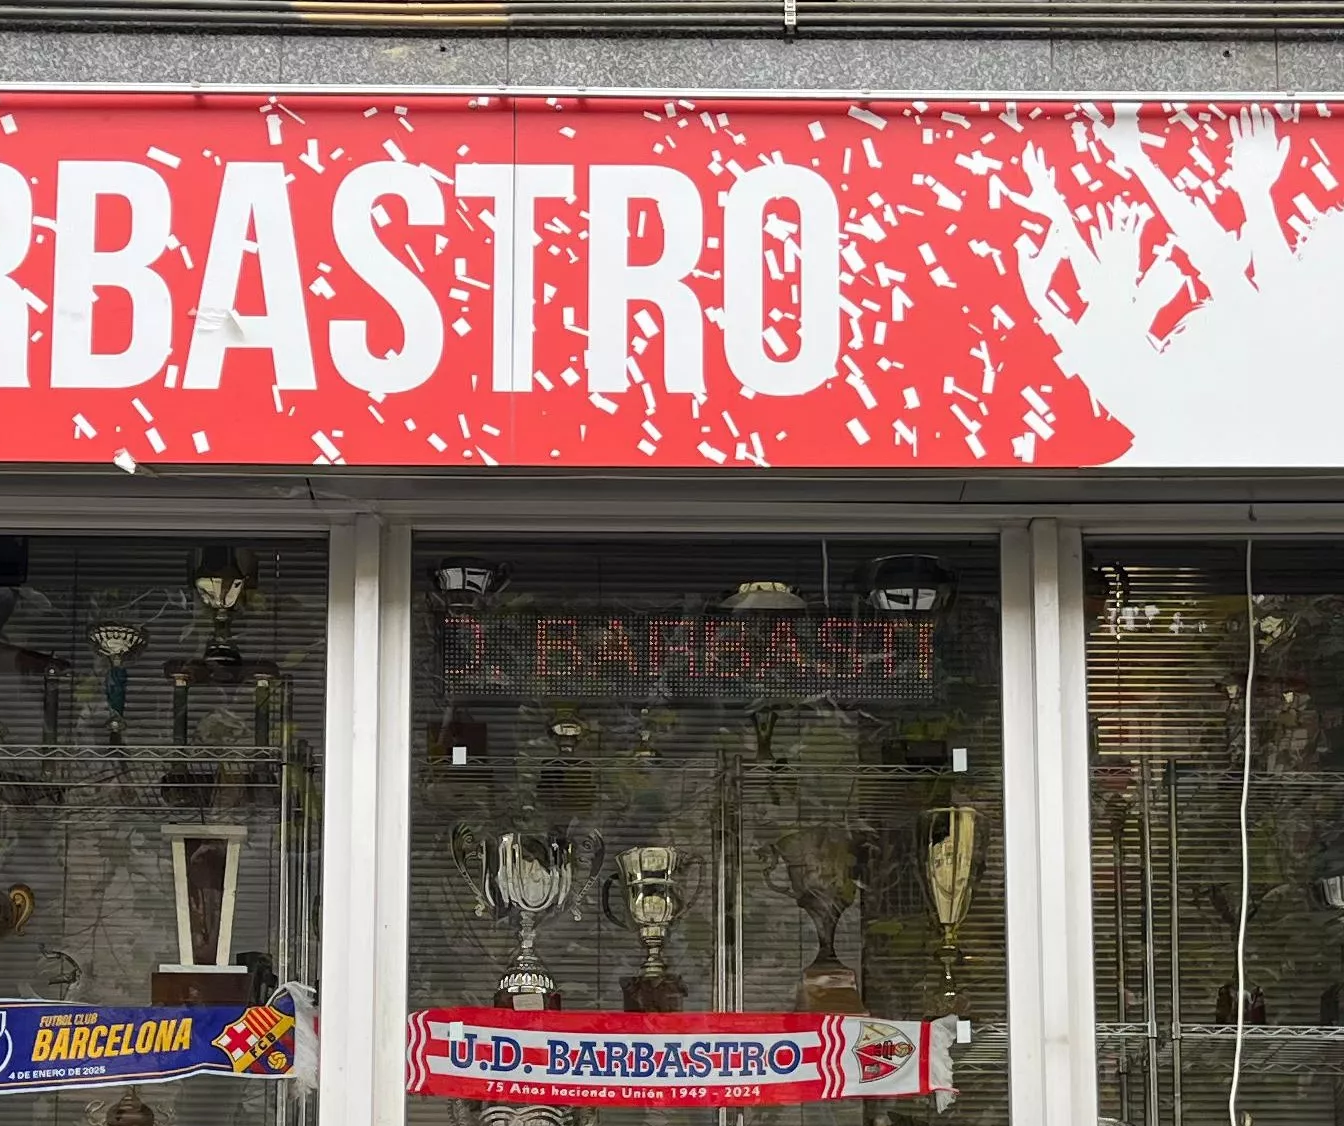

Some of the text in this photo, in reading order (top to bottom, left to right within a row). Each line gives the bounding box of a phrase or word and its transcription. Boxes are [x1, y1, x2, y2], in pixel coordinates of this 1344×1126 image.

[74, 1012, 98, 1026] CLUB
[30, 1016, 193, 1063] BARCELONA
[447, 1032, 802, 1079] U.D. BARBASTRO
[7, 1065, 107, 1081] 4 DE ENERO DE 2025
[486, 1081, 504, 1093] 75
[509, 1082, 546, 1096] Años
[551, 1086, 616, 1099] haciendo
[621, 1085, 664, 1099] Unión
[670, 1086, 707, 1099] 1949
[723, 1086, 761, 1099] 2024
